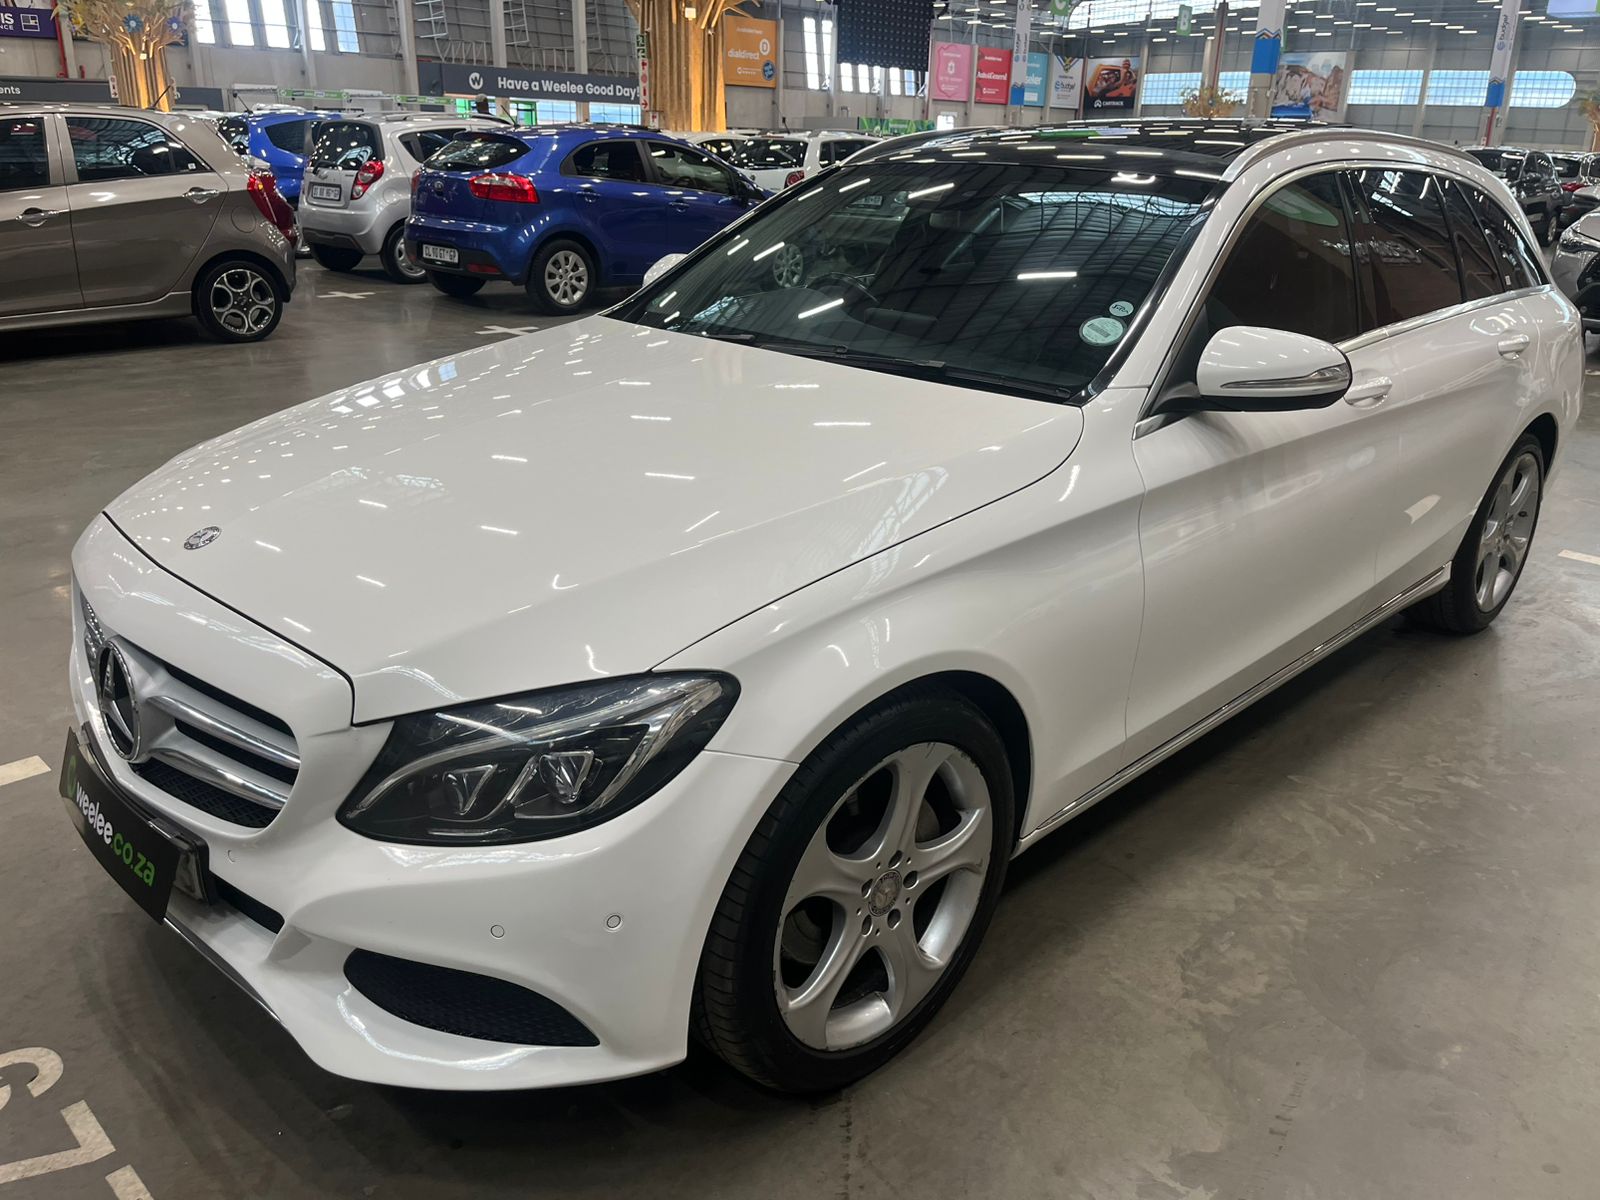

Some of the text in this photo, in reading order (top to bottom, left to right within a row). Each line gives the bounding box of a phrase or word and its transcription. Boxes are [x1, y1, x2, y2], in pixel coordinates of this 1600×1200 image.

[497, 76, 640, 101] Have a Weelee Good Day!
[76, 781, 156, 887] weelee.co.za
